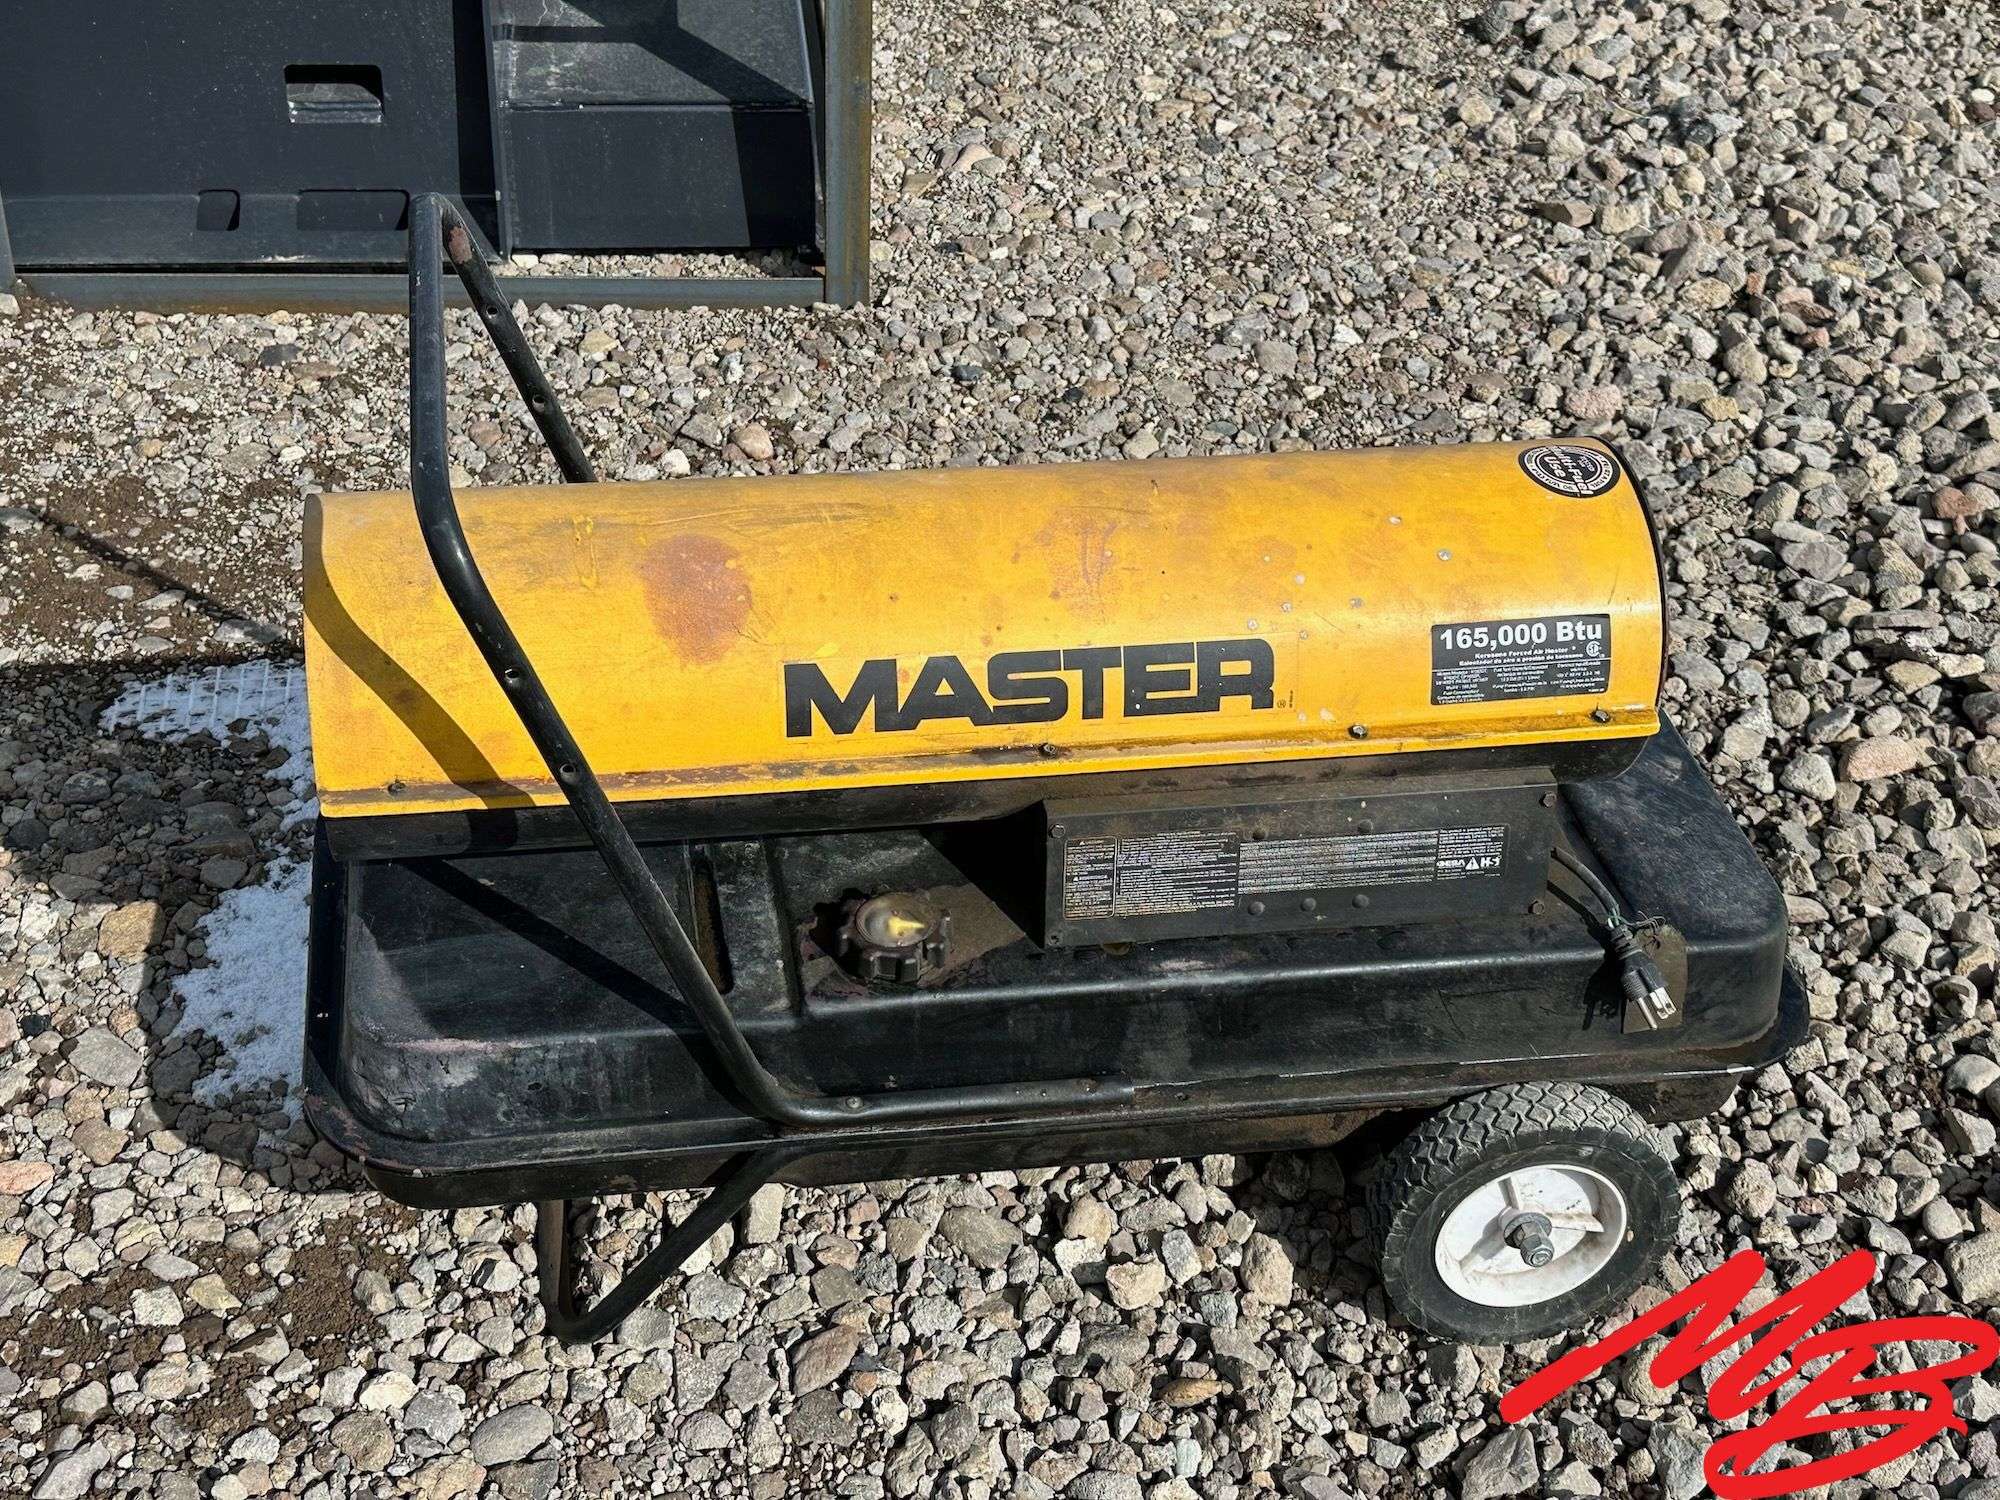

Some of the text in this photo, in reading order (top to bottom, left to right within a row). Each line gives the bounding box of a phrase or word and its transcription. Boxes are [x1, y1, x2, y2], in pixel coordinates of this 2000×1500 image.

[1543, 456, 1567, 478] Use
[1439, 620, 1602, 651] 165,000 Btu
[784, 637, 1274, 738] MASTER
